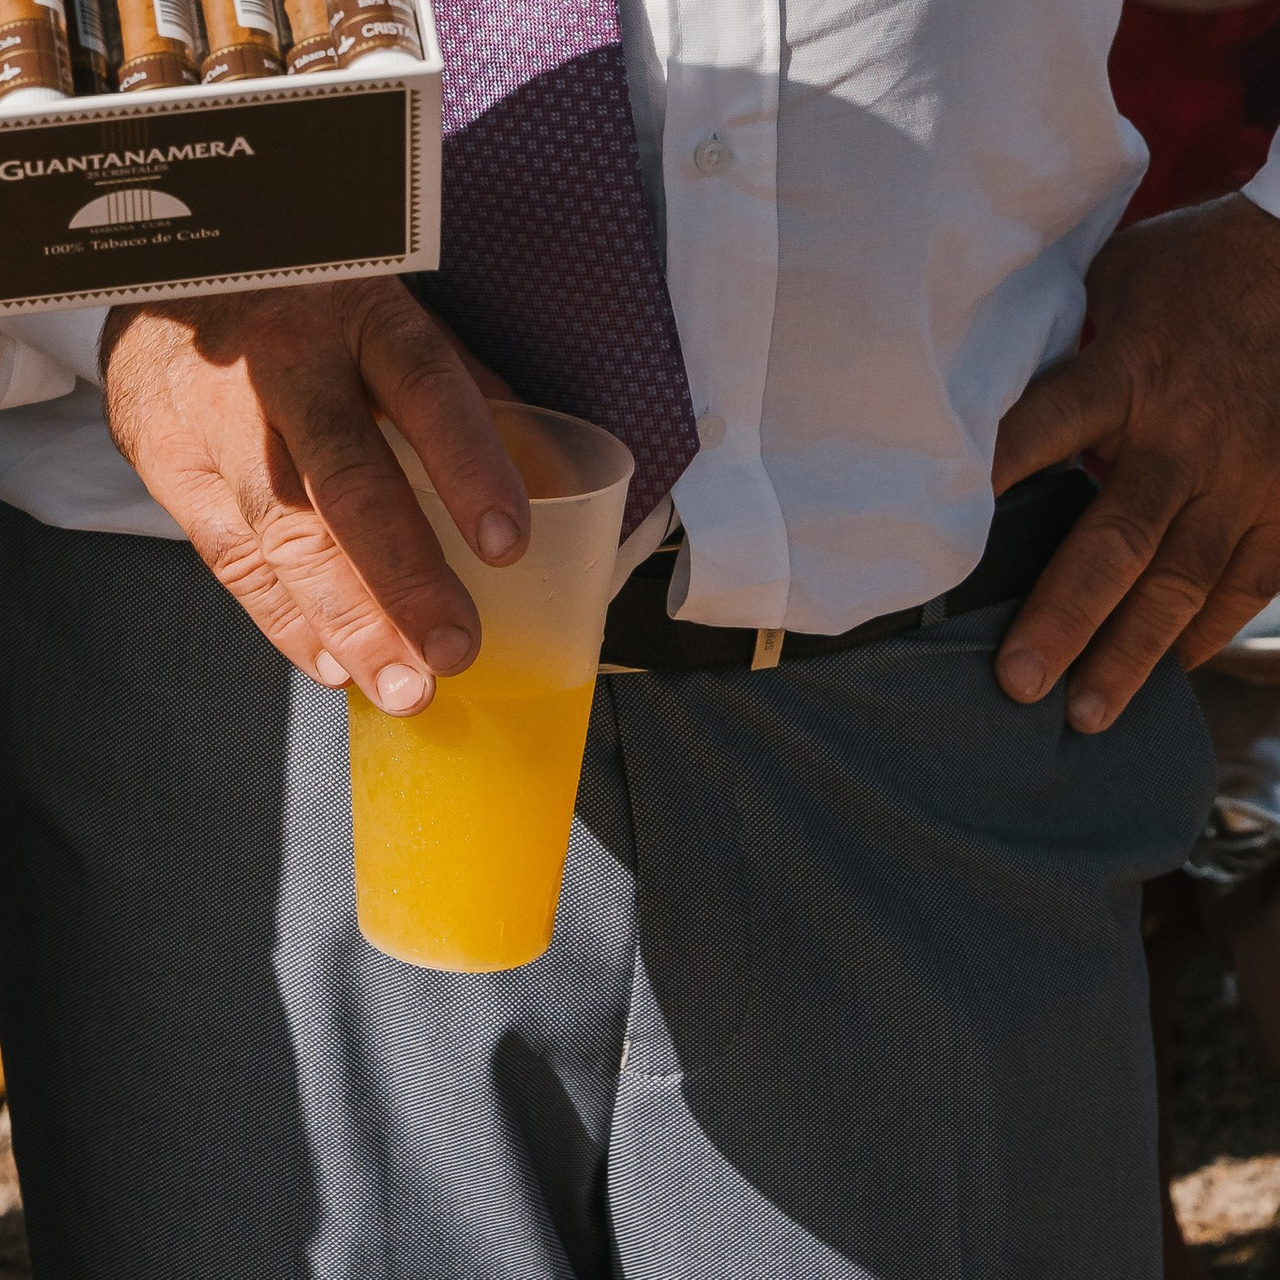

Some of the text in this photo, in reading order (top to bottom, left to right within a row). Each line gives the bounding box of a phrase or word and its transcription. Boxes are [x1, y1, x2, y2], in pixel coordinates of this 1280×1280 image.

[101, 163, 169, 179] CRISTALES
[43, 227, 221, 256] 100% Tabaco de Cuba
